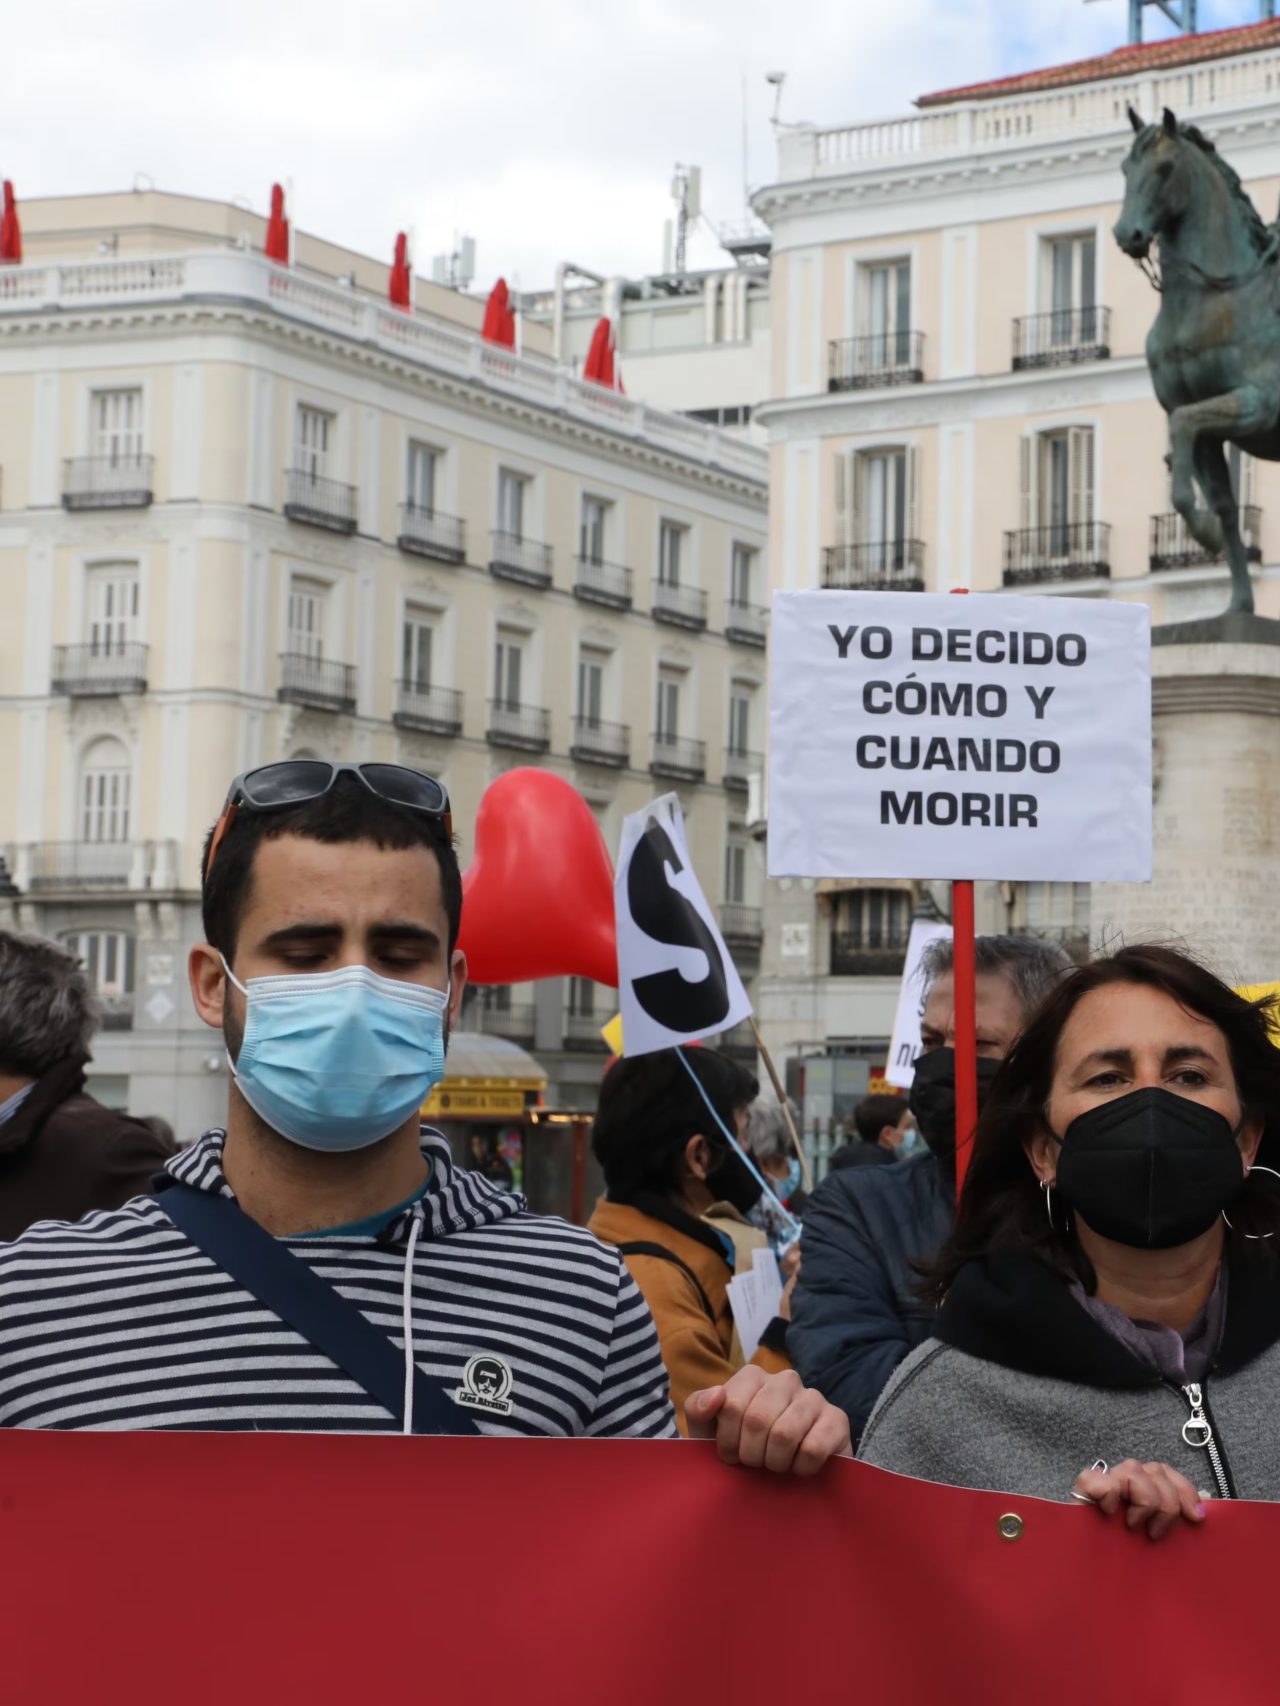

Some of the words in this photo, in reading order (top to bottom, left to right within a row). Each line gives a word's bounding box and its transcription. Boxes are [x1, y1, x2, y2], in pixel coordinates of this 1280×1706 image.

[827, 624, 892, 661] YO
[910, 626, 1087, 667] DECIDO
[862, 671, 1007, 719] CÓMO
[1024, 685, 1056, 720] Y
[855, 734, 1061, 774] CUANDO
[879, 790, 1039, 828] MORIR
